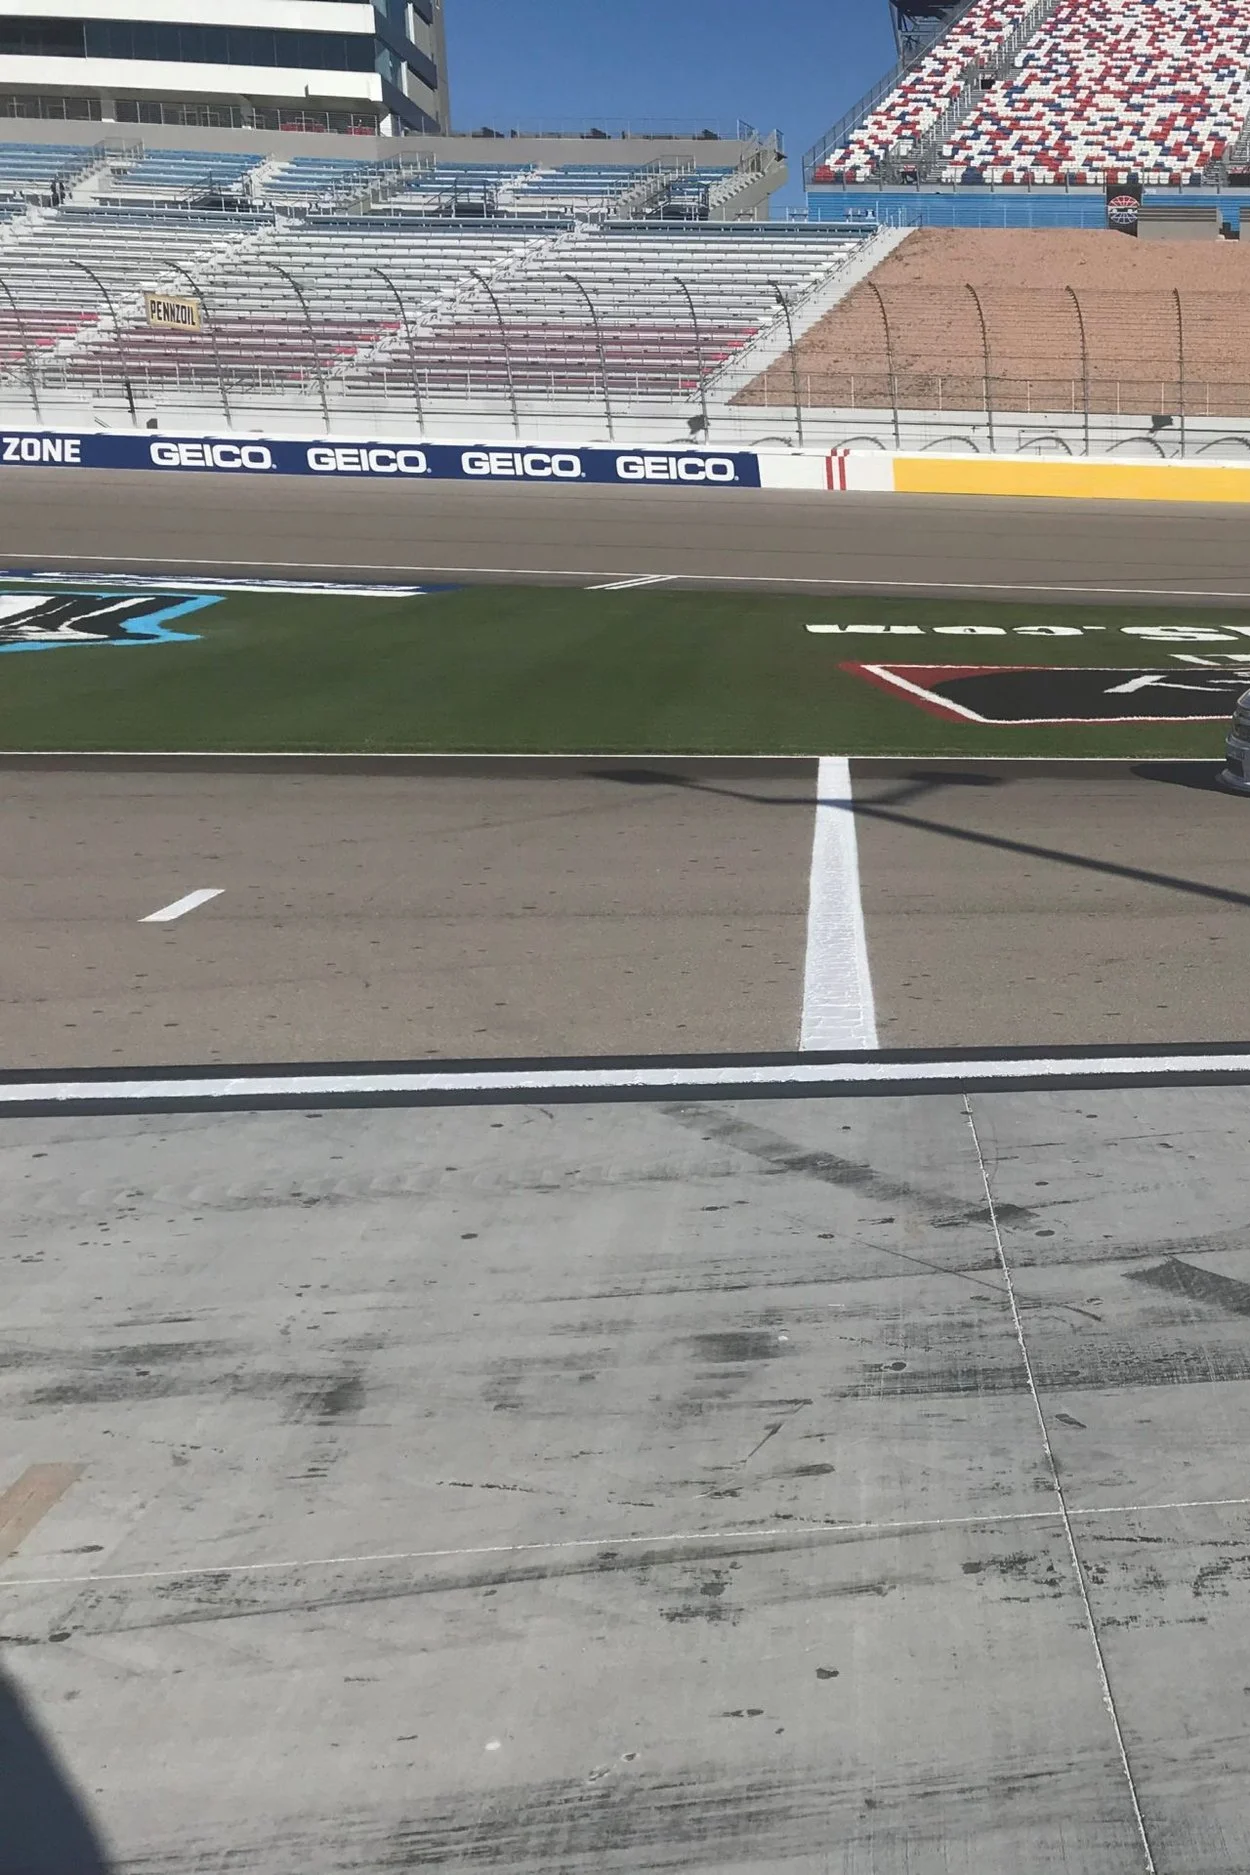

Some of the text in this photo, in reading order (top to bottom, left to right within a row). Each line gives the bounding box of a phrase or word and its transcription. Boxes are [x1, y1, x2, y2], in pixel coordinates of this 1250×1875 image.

[150, 299, 196, 326] PENNZOIL
[2, 437, 81, 463] ZONE
[150, 442, 274, 470] GEICO
[307, 447, 428, 474] GEICO
[461, 451, 583, 478] GEICO
[615, 455, 736, 482] GEICO
